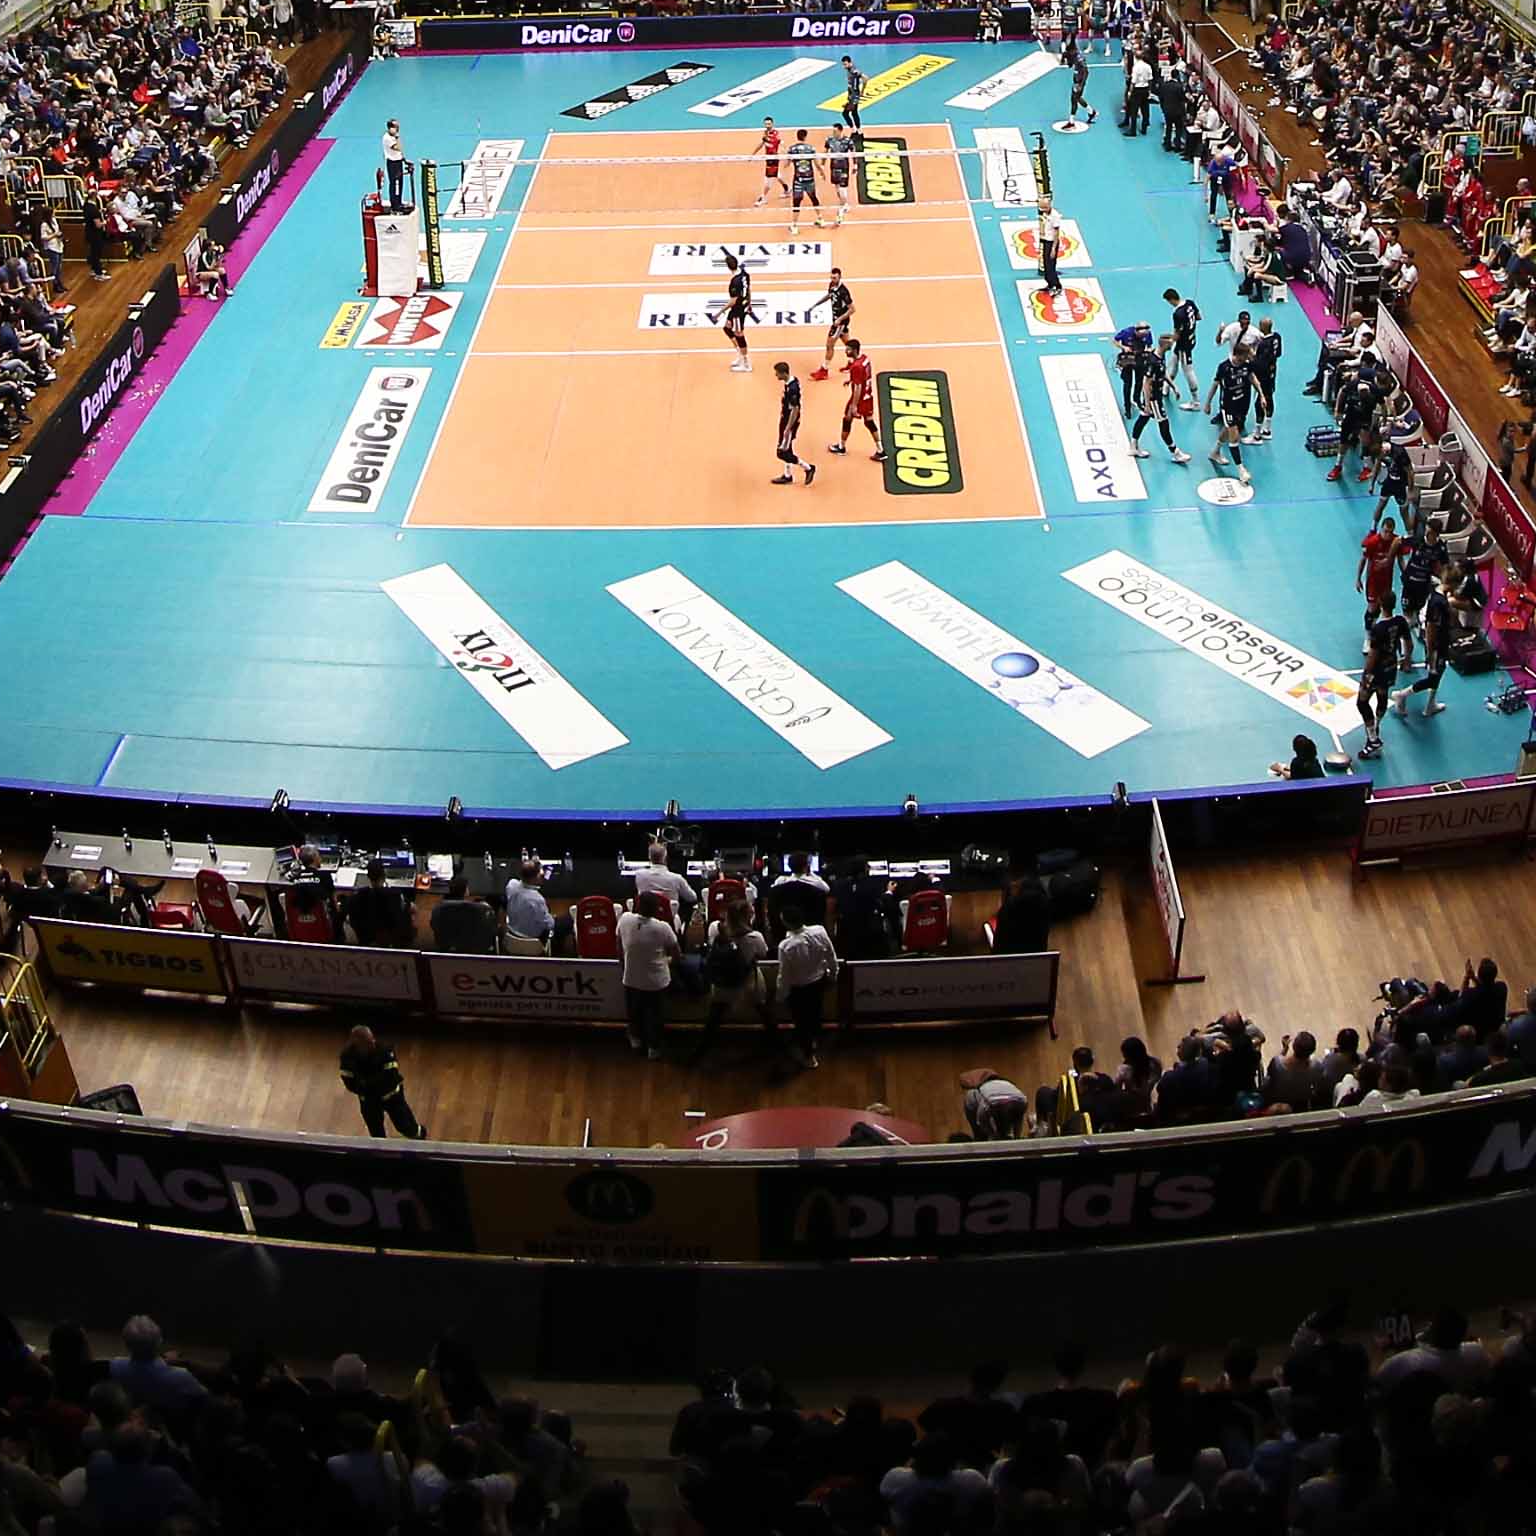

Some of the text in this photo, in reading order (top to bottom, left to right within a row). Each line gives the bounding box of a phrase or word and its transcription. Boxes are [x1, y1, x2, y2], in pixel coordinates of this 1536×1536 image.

[521, 23, 612, 45] DeniCar
[792, 16, 889, 39] DeniCar
[322, 65, 349, 109] DeniCar
[236, 168, 272, 223] DeniCar
[338, 303, 365, 338] MIKASA
[650, 310, 825, 327] REVVRE
[80, 344, 134, 435] DeniCar
[326, 396, 411, 506] DeniCar
[889, 376, 951, 488] CREDEM
[1066, 378, 1119, 499] AXOPOWER
[1099, 577, 1282, 686] vicolungo
[660, 610, 797, 717] GRANAIO
[1368, 803, 1523, 837] DIETALINEA
[99, 948, 205, 974] TIGROS
[450, 968, 600, 996] e-work
[856, 980, 1016, 1001] AXOPOWER
[850, 1170, 1216, 1238] onald's
